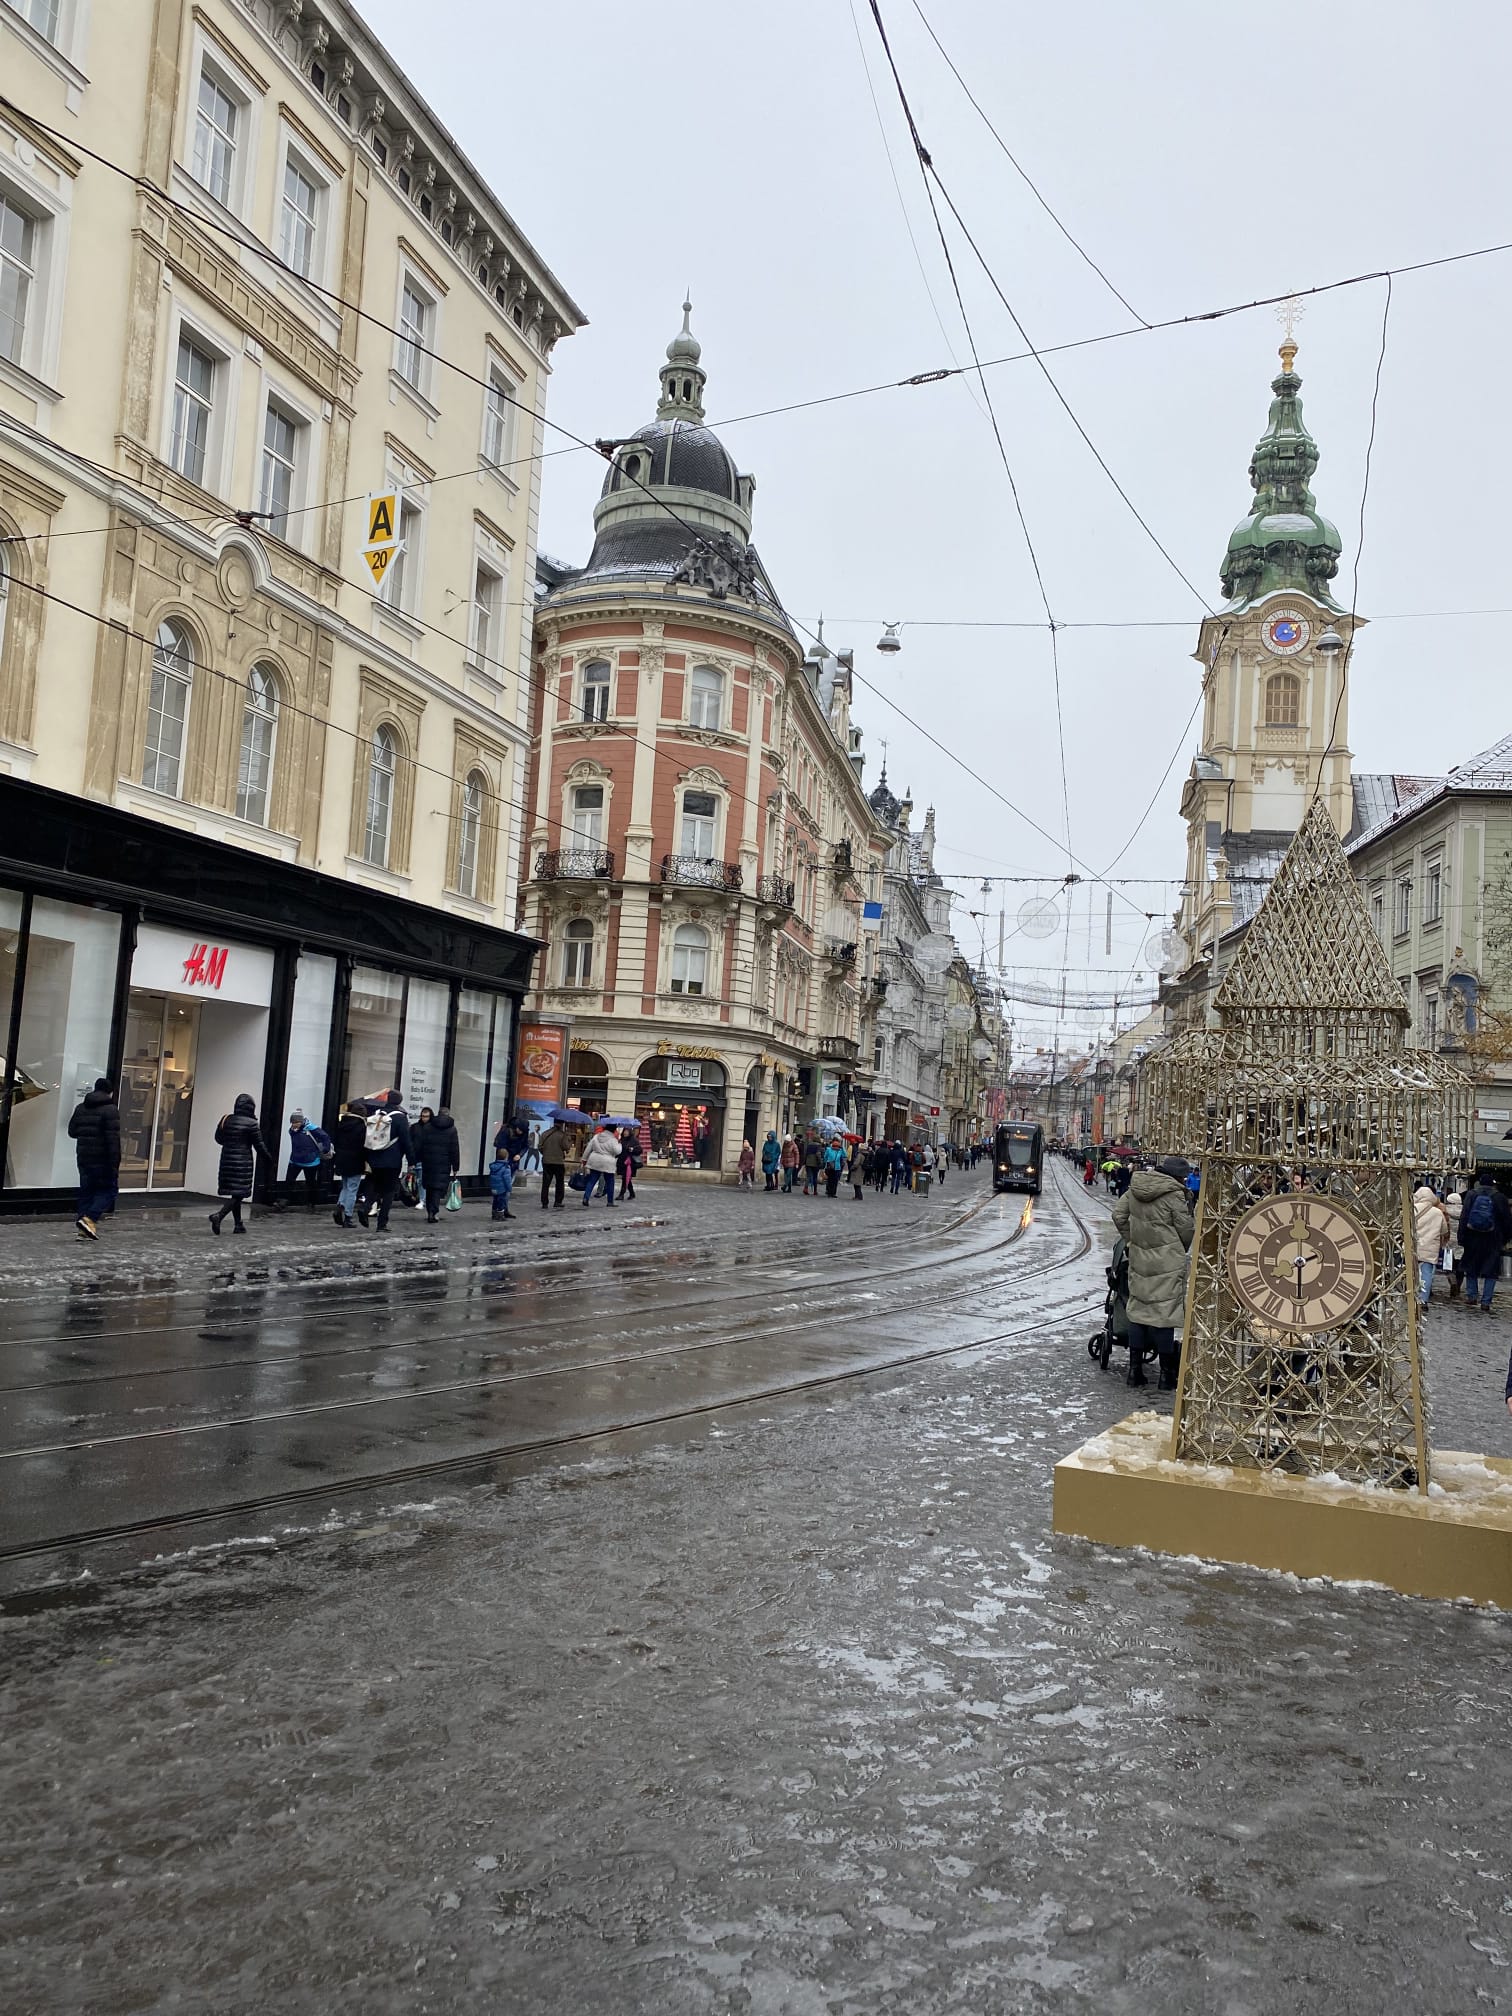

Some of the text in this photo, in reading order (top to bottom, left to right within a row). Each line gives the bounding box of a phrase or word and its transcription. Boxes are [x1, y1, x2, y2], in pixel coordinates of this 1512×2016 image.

[369, 501, 392, 539] A
[372, 550, 388, 570] 20
[182, 943, 229, 990] H&M
[676, 1044, 721, 1059] Tchibo
[671, 1063, 699, 1078] Qbo
